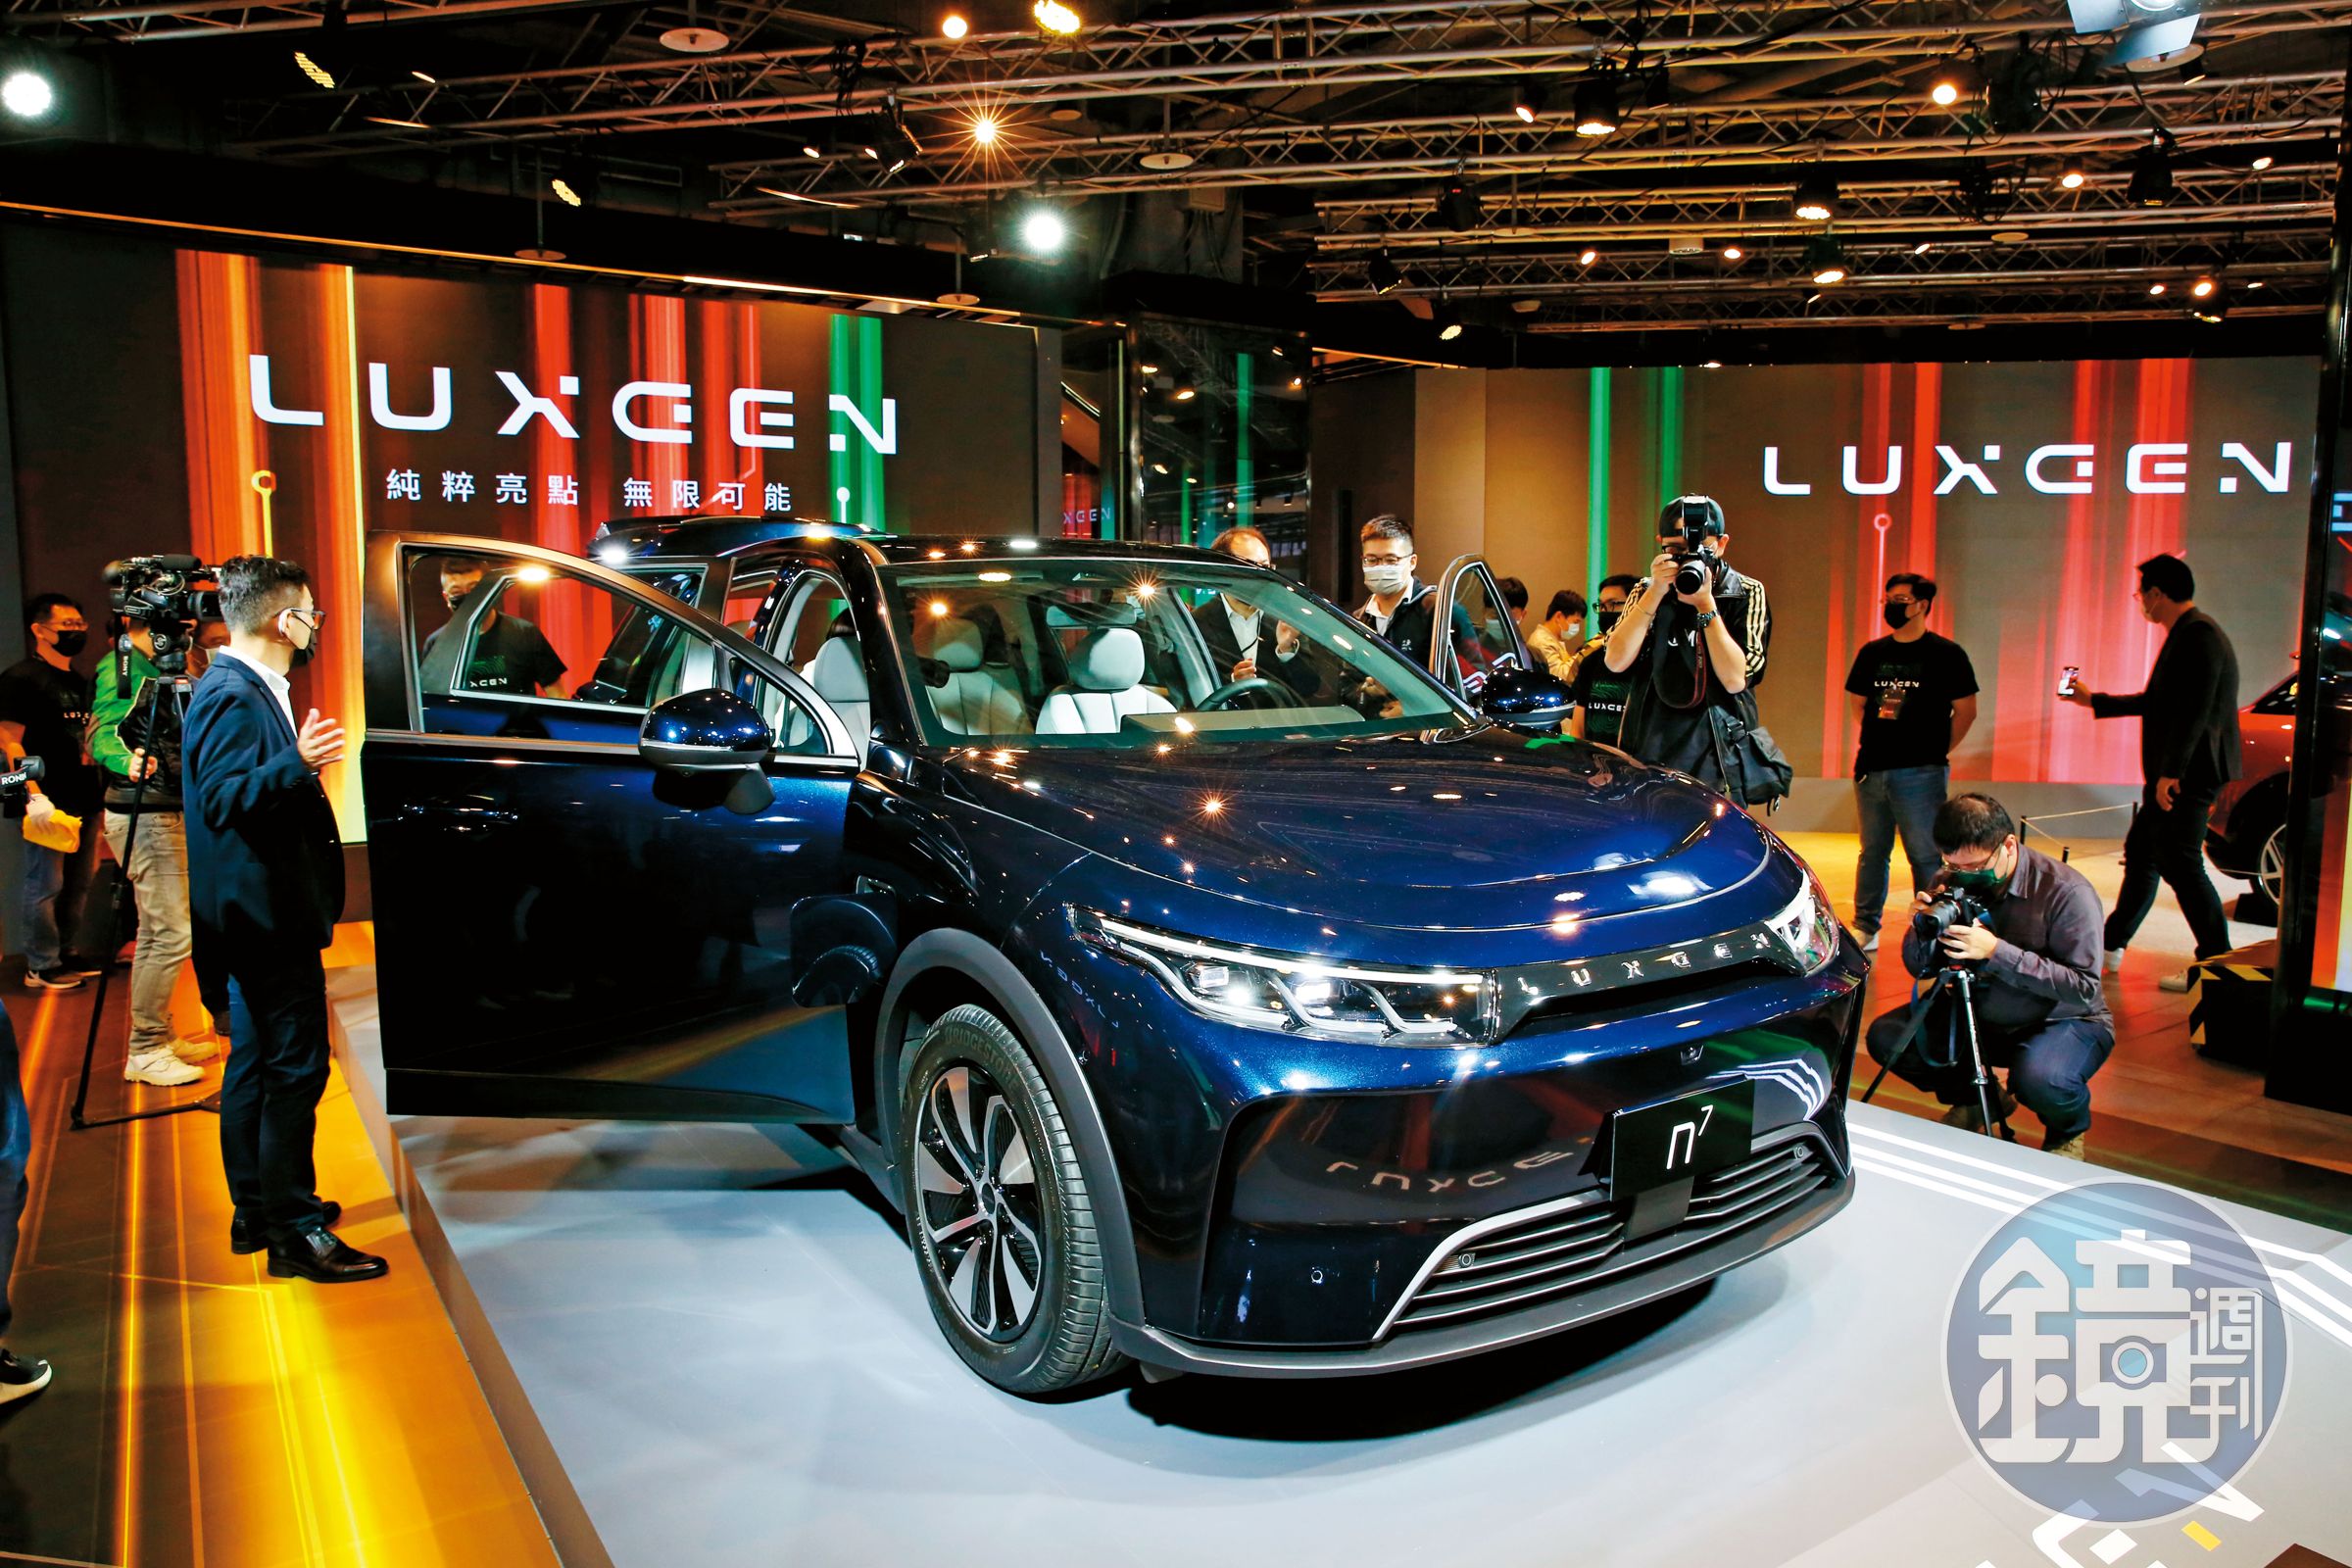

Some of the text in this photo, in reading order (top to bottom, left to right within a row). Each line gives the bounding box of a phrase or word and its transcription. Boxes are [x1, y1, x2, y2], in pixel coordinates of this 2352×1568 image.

[250, 354, 897, 455] LUXGEN
[386, 467, 792, 513] 純粹亮點 無限可能
[1764, 441, 2291, 495] LUXGEN
[1518, 932, 1771, 996] LUXGEN
